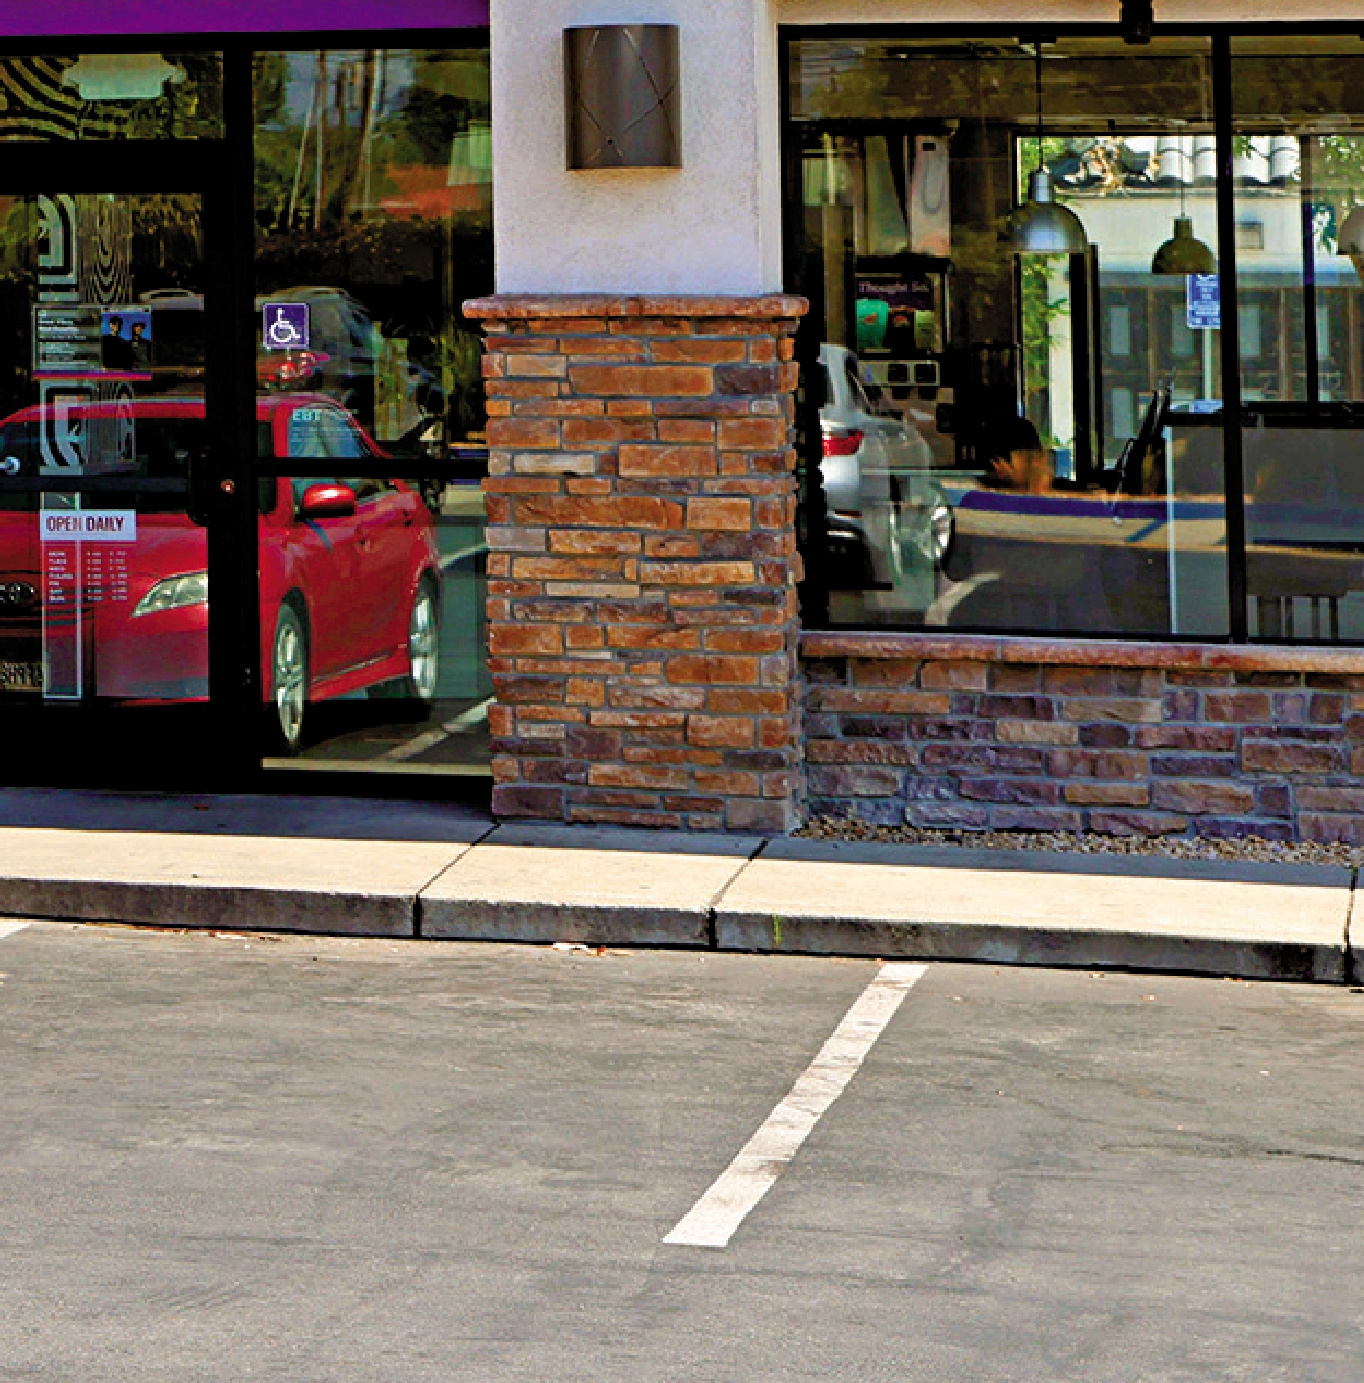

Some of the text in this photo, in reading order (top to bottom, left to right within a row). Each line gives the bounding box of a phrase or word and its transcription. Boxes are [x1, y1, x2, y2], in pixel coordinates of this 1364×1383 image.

[292, 408, 323, 421] EBT
[45, 515, 124, 532] OPEN DAILY
